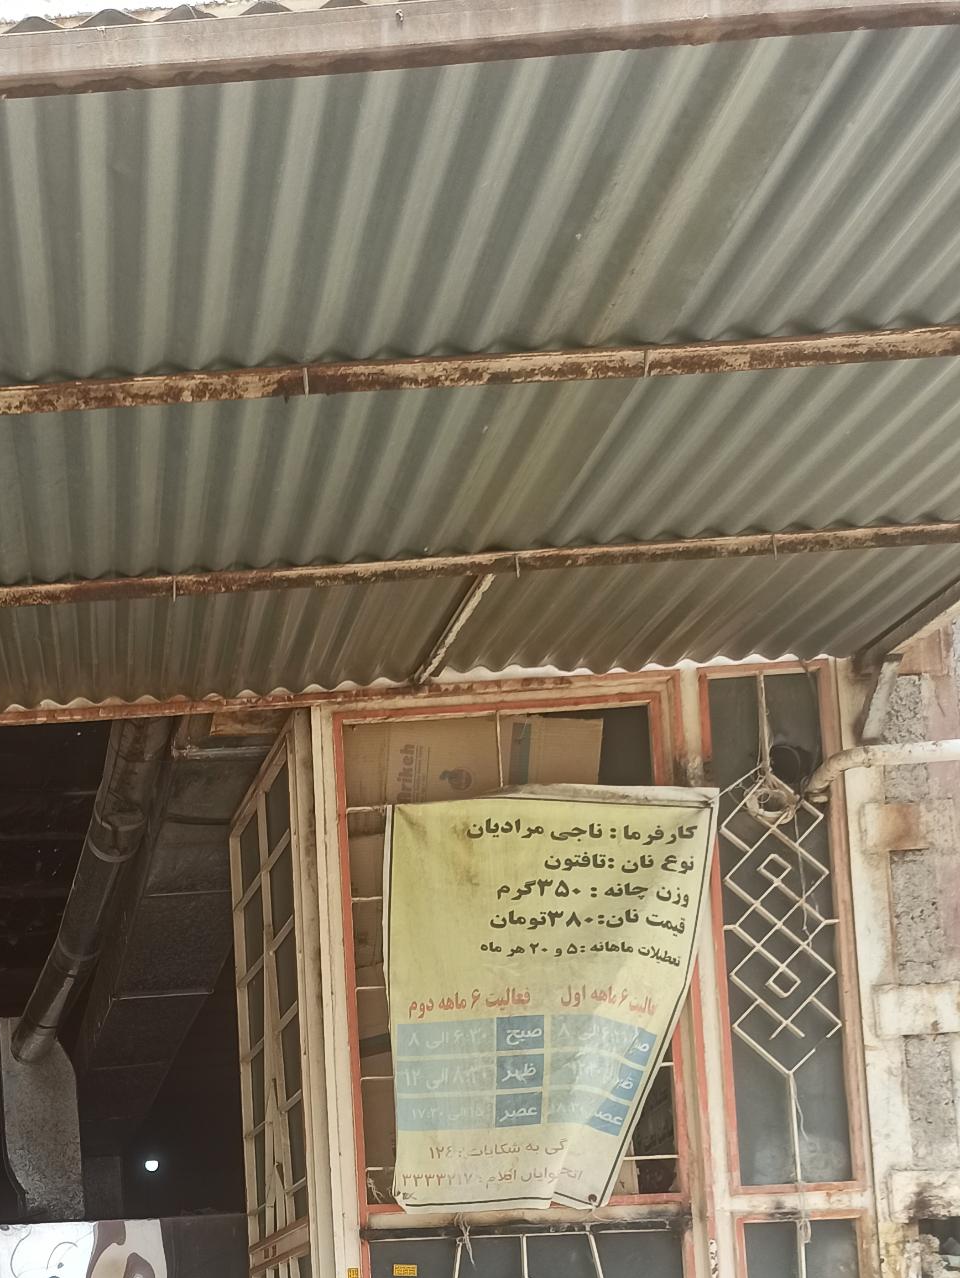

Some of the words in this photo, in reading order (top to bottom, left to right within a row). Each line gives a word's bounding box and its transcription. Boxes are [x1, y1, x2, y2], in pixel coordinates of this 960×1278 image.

[466, 818, 545, 840] مرادیان
[550, 823, 603, 842] ناجی
[621, 855, 654, 873] نان
[661, 854, 695, 875] نوع
[604, 882, 649, 900] چانه
[656, 886, 690, 908] وزن
[645, 912, 686, 937] قیمت
[480, 941, 502, 952] ماه
[506, 945, 526, 957] هر
[529, 942, 548, 953] ۲۰
[554, 946, 563, 957] و
[590, 940, 634, 953] ماهانه
[438, 991, 467, 1011] ماهه
[471, 988, 481, 1010] ۶
[485, 987, 531, 1011] فعالیت
[560, 984, 586, 1007] اول
[408, 1000, 435, 1020] دوم
[407, 1032, 420, 1047] ۸
[426, 1031, 450, 1050] الی
[506, 1026, 543, 1046] صبح
[501, 1063, 537, 1085] ظهر
[499, 1104, 538, 1122] عصر
[525, 1144, 540, 1155] به
